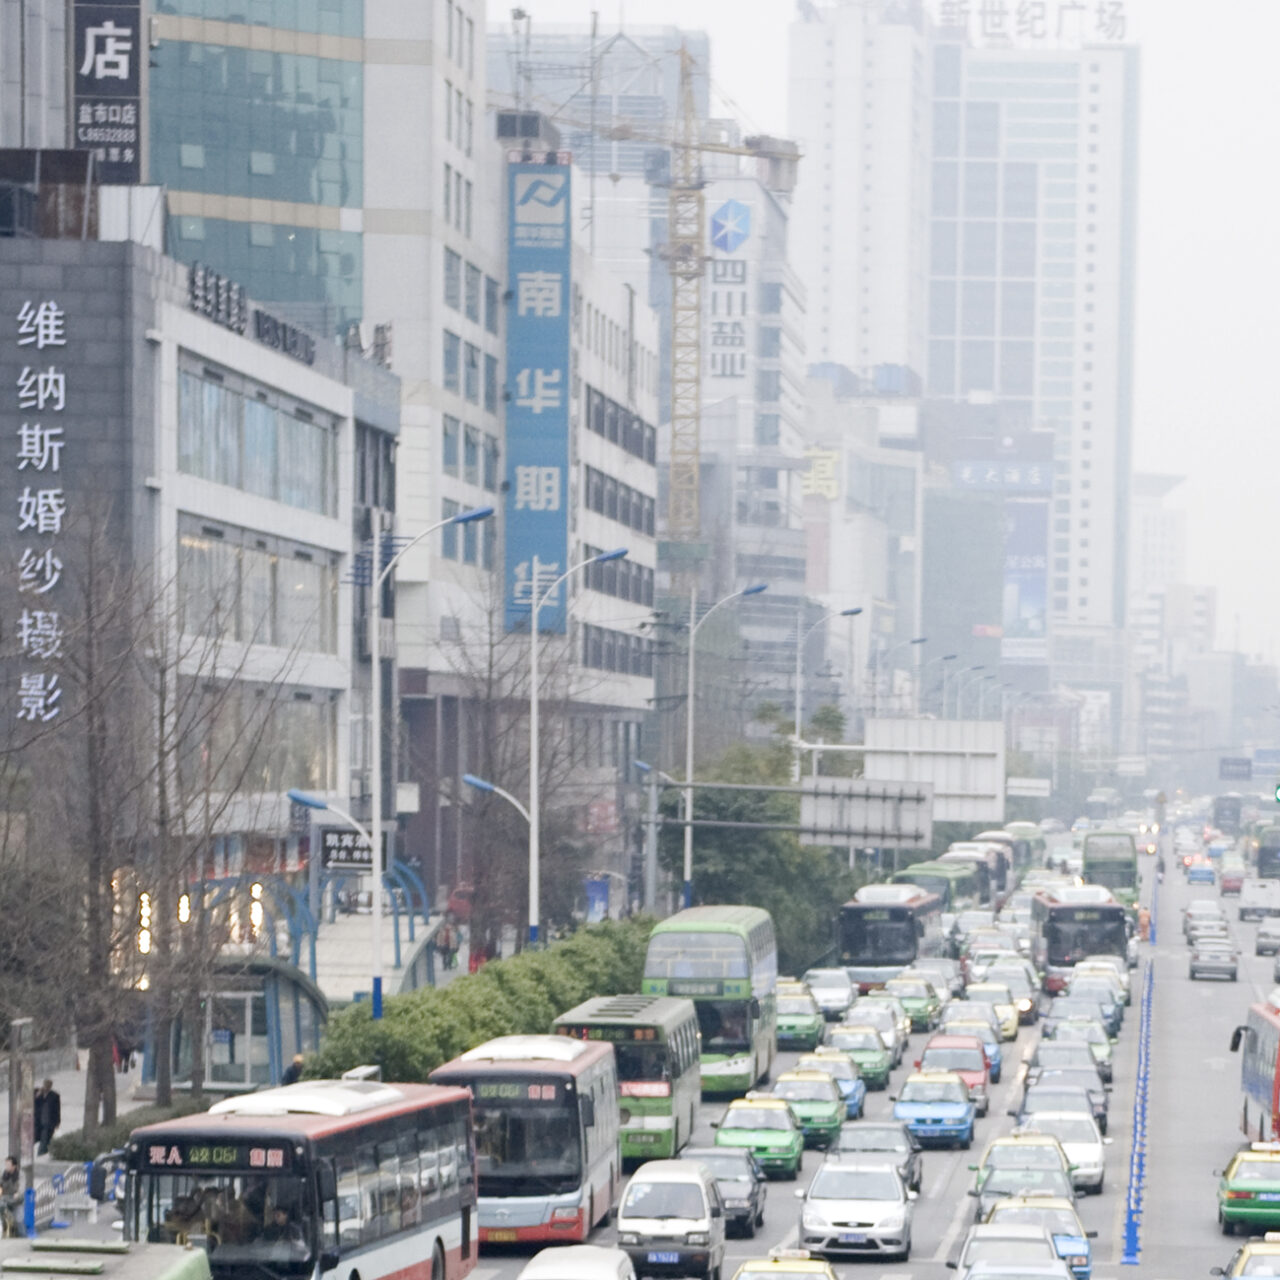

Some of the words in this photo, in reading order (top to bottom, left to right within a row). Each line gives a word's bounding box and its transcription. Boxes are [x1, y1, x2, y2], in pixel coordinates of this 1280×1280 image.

[80, 20, 132, 79] 店
[939, 0, 1127, 41] 新世纪广场
[79, 103, 136, 124] 盐市口店
[711, 258, 746, 377] 四川盐业
[17, 300, 66, 722] 维纳斯婚纱摄影
